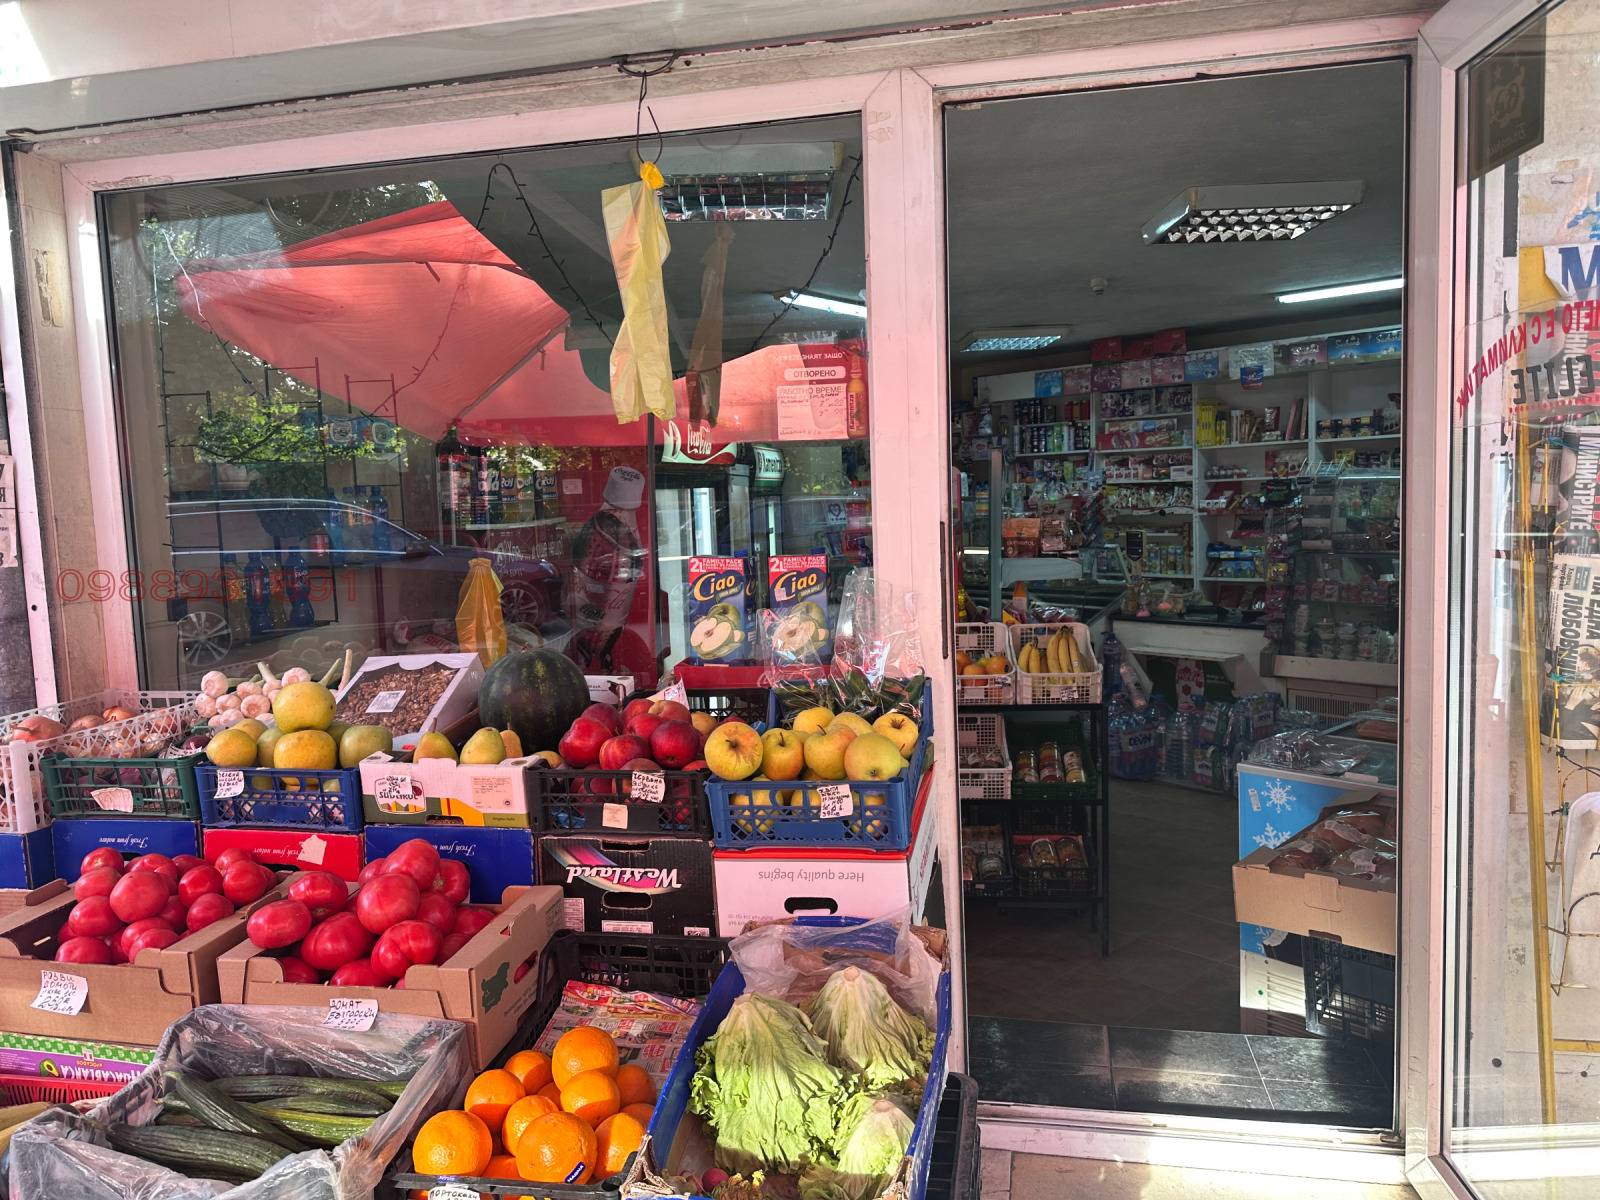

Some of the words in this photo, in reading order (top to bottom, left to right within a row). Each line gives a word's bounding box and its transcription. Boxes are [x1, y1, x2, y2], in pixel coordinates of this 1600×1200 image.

[793, 369, 836, 379] ОТВОРЕНО
[779, 387, 813, 395] РАБОТНО
[693, 573, 735, 601] Ciao
[775, 572, 818, 601] Ciao
[98, 837, 116, 845] nature
[116, 833, 133, 847] from
[129, 837, 149, 849] Fresh
[439, 840, 459, 854] from
[566, 864, 682, 889] Westland
[758, 868, 794, 882] begins
[796, 868, 835, 882] quality
[838, 871, 865, 882] Here
